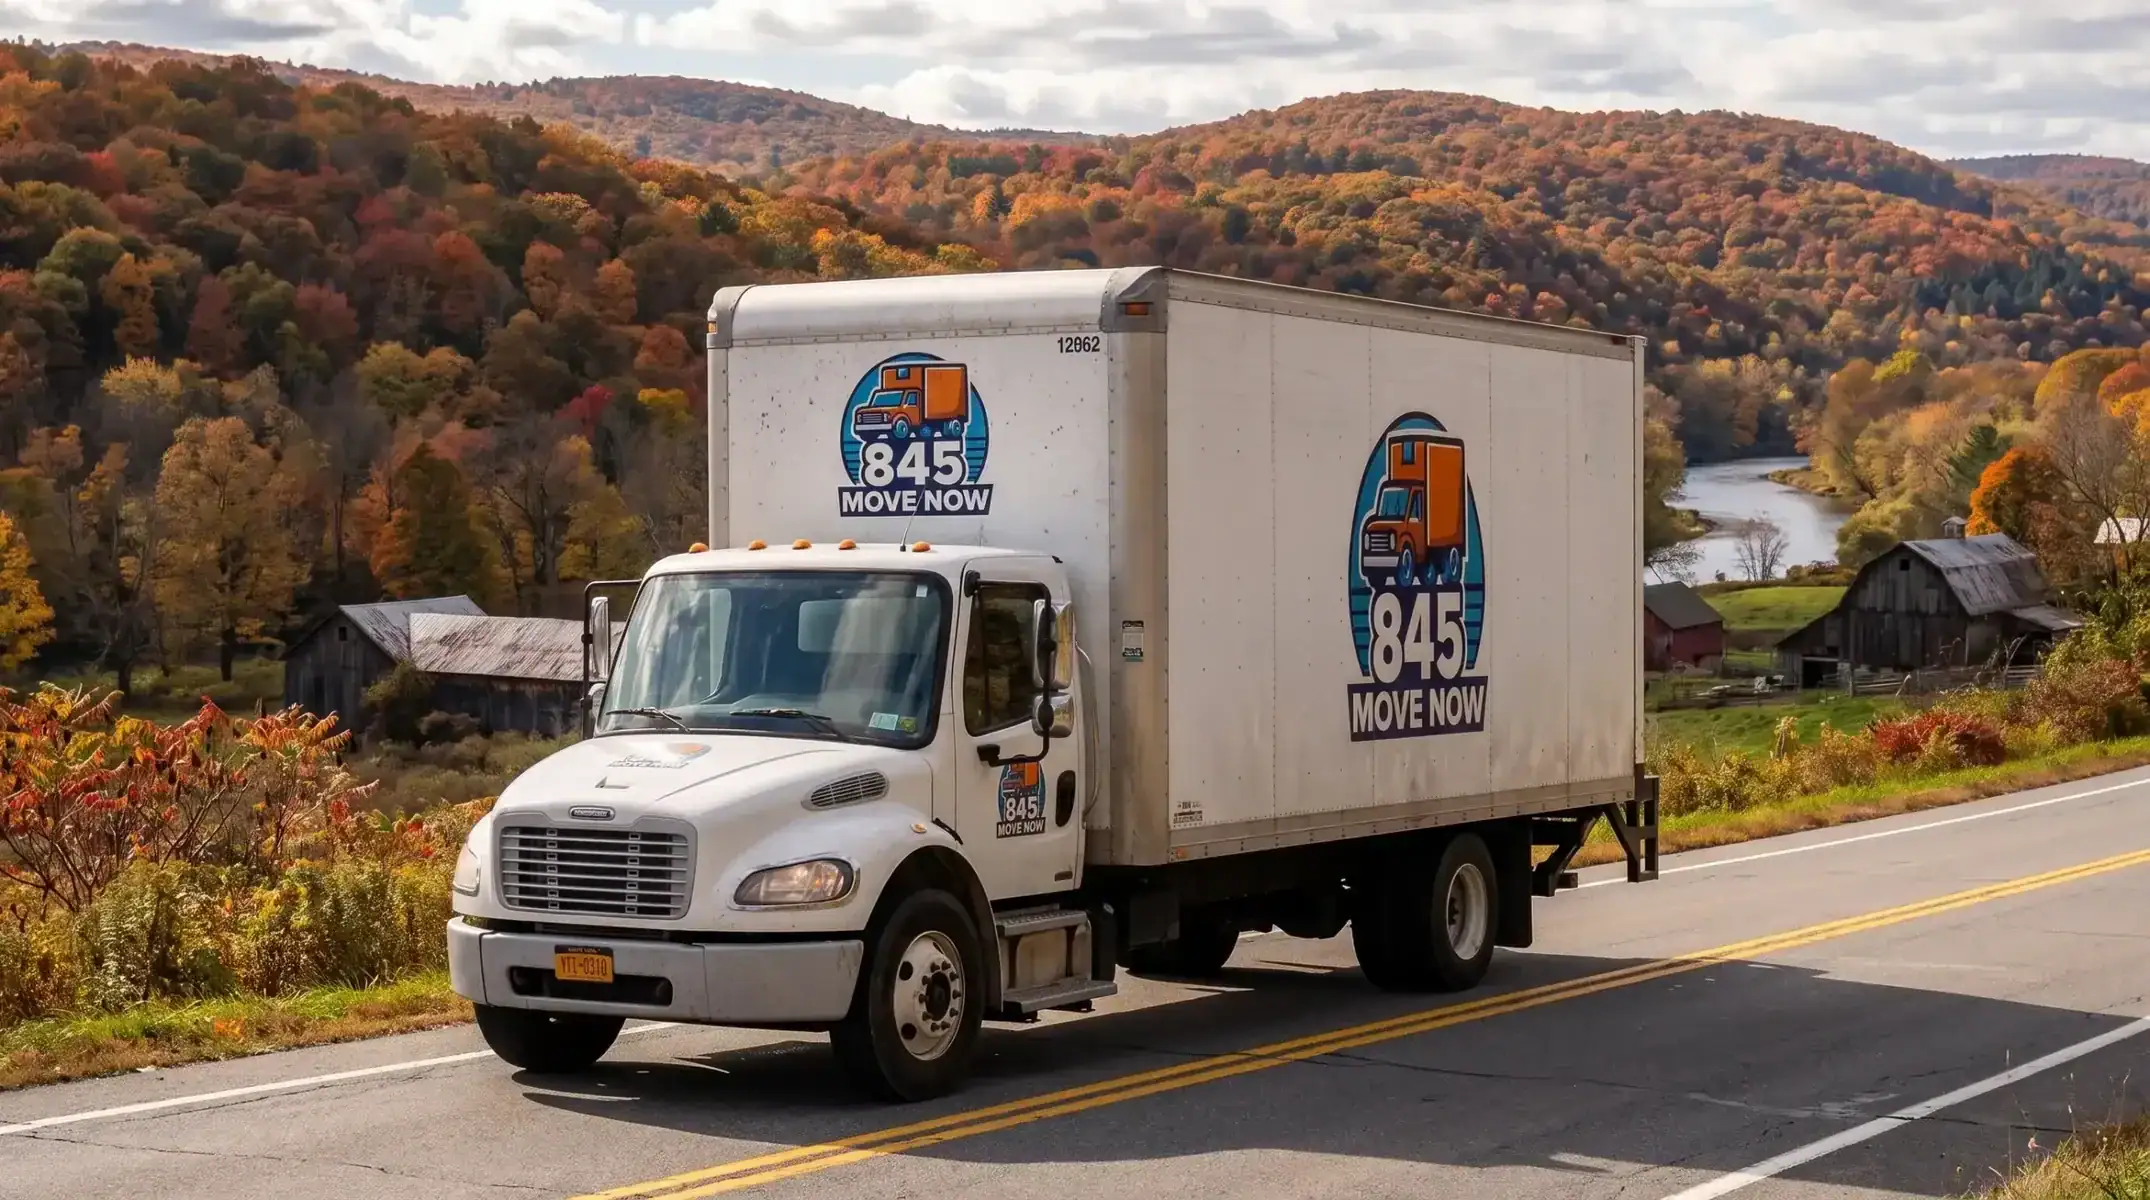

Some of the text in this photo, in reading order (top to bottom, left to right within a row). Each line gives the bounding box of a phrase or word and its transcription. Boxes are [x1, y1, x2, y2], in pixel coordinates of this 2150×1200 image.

[864, 440, 964, 487] 845
[842, 488, 989, 512] MOVE NOW
[1373, 591, 1465, 684] 845
[1352, 685, 1485, 733] MOVE NOW
[1006, 796, 1038, 822] 845
[998, 819, 1044, 837] MOVE NOW
